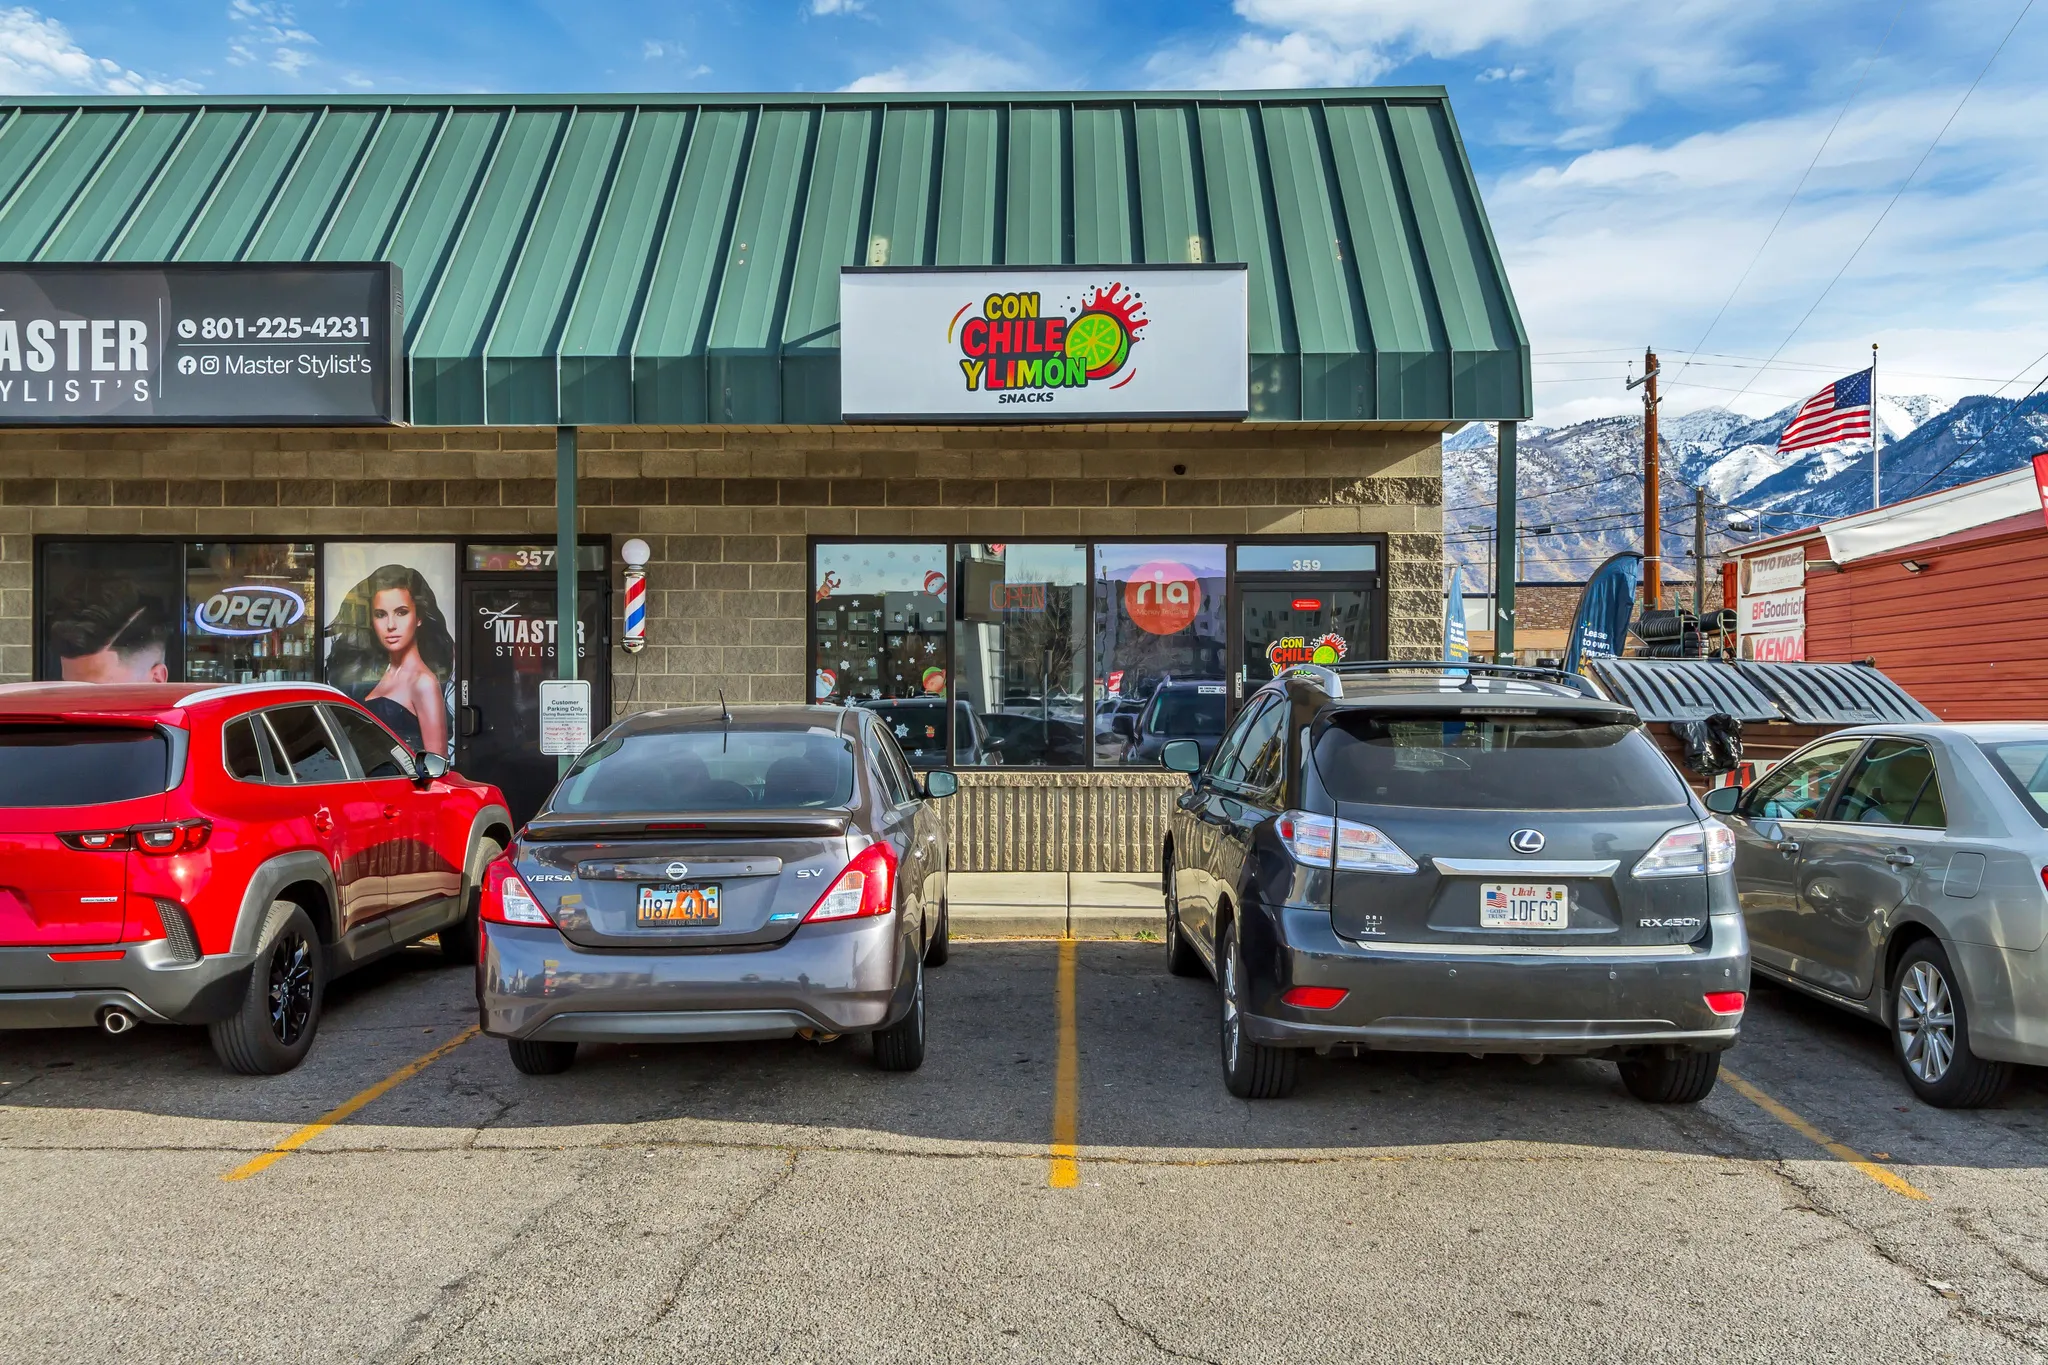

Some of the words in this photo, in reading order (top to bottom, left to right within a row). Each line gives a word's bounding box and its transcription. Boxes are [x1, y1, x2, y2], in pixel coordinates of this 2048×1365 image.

[986, 294, 1038, 320] CON
[201, 316, 370, 339] 801-225-4231
[963, 319, 1065, 356] CHILE
[0, 319, 148, 372] ASTER
[226, 355, 294, 374] Master
[298, 354, 372, 379] Stylist's
[962, 361, 985, 389] Y
[987, 352, 1086, 389] LIMÓN
[0, 379, 148, 402] YLIST'S
[998, 392, 1054, 404] SNACKS
[516, 550, 556, 566] 357
[1292, 559, 1321, 571] 359
[1752, 556, 1776, 574] TOYO
[1777, 551, 1804, 569] TIRES
[991, 583, 1045, 609] OPEN
[1137, 569, 1189, 605] ria
[202, 594, 294, 629] OPEN
[1752, 597, 1804, 621] BFGoodrich
[495, 620, 585, 644] MASTR
[1584, 627, 1608, 640] Lease
[495, 646, 585, 658] STYLISS
[1281, 638, 1303, 649] CON
[1582, 638, 1591, 647] to
[1592, 641, 1610, 650] own
[1271, 647, 1314, 663] CHILE
[526, 874, 573, 882] VERSA
[797, 868, 824, 878] SV
[1512, 887, 1536, 897] Utah
[1546, 891, 1552, 900] 3
[643, 899, 674, 919] U87
[685, 898, 716, 919] 4JC
[1509, 900, 1558, 922] 1DFG3
